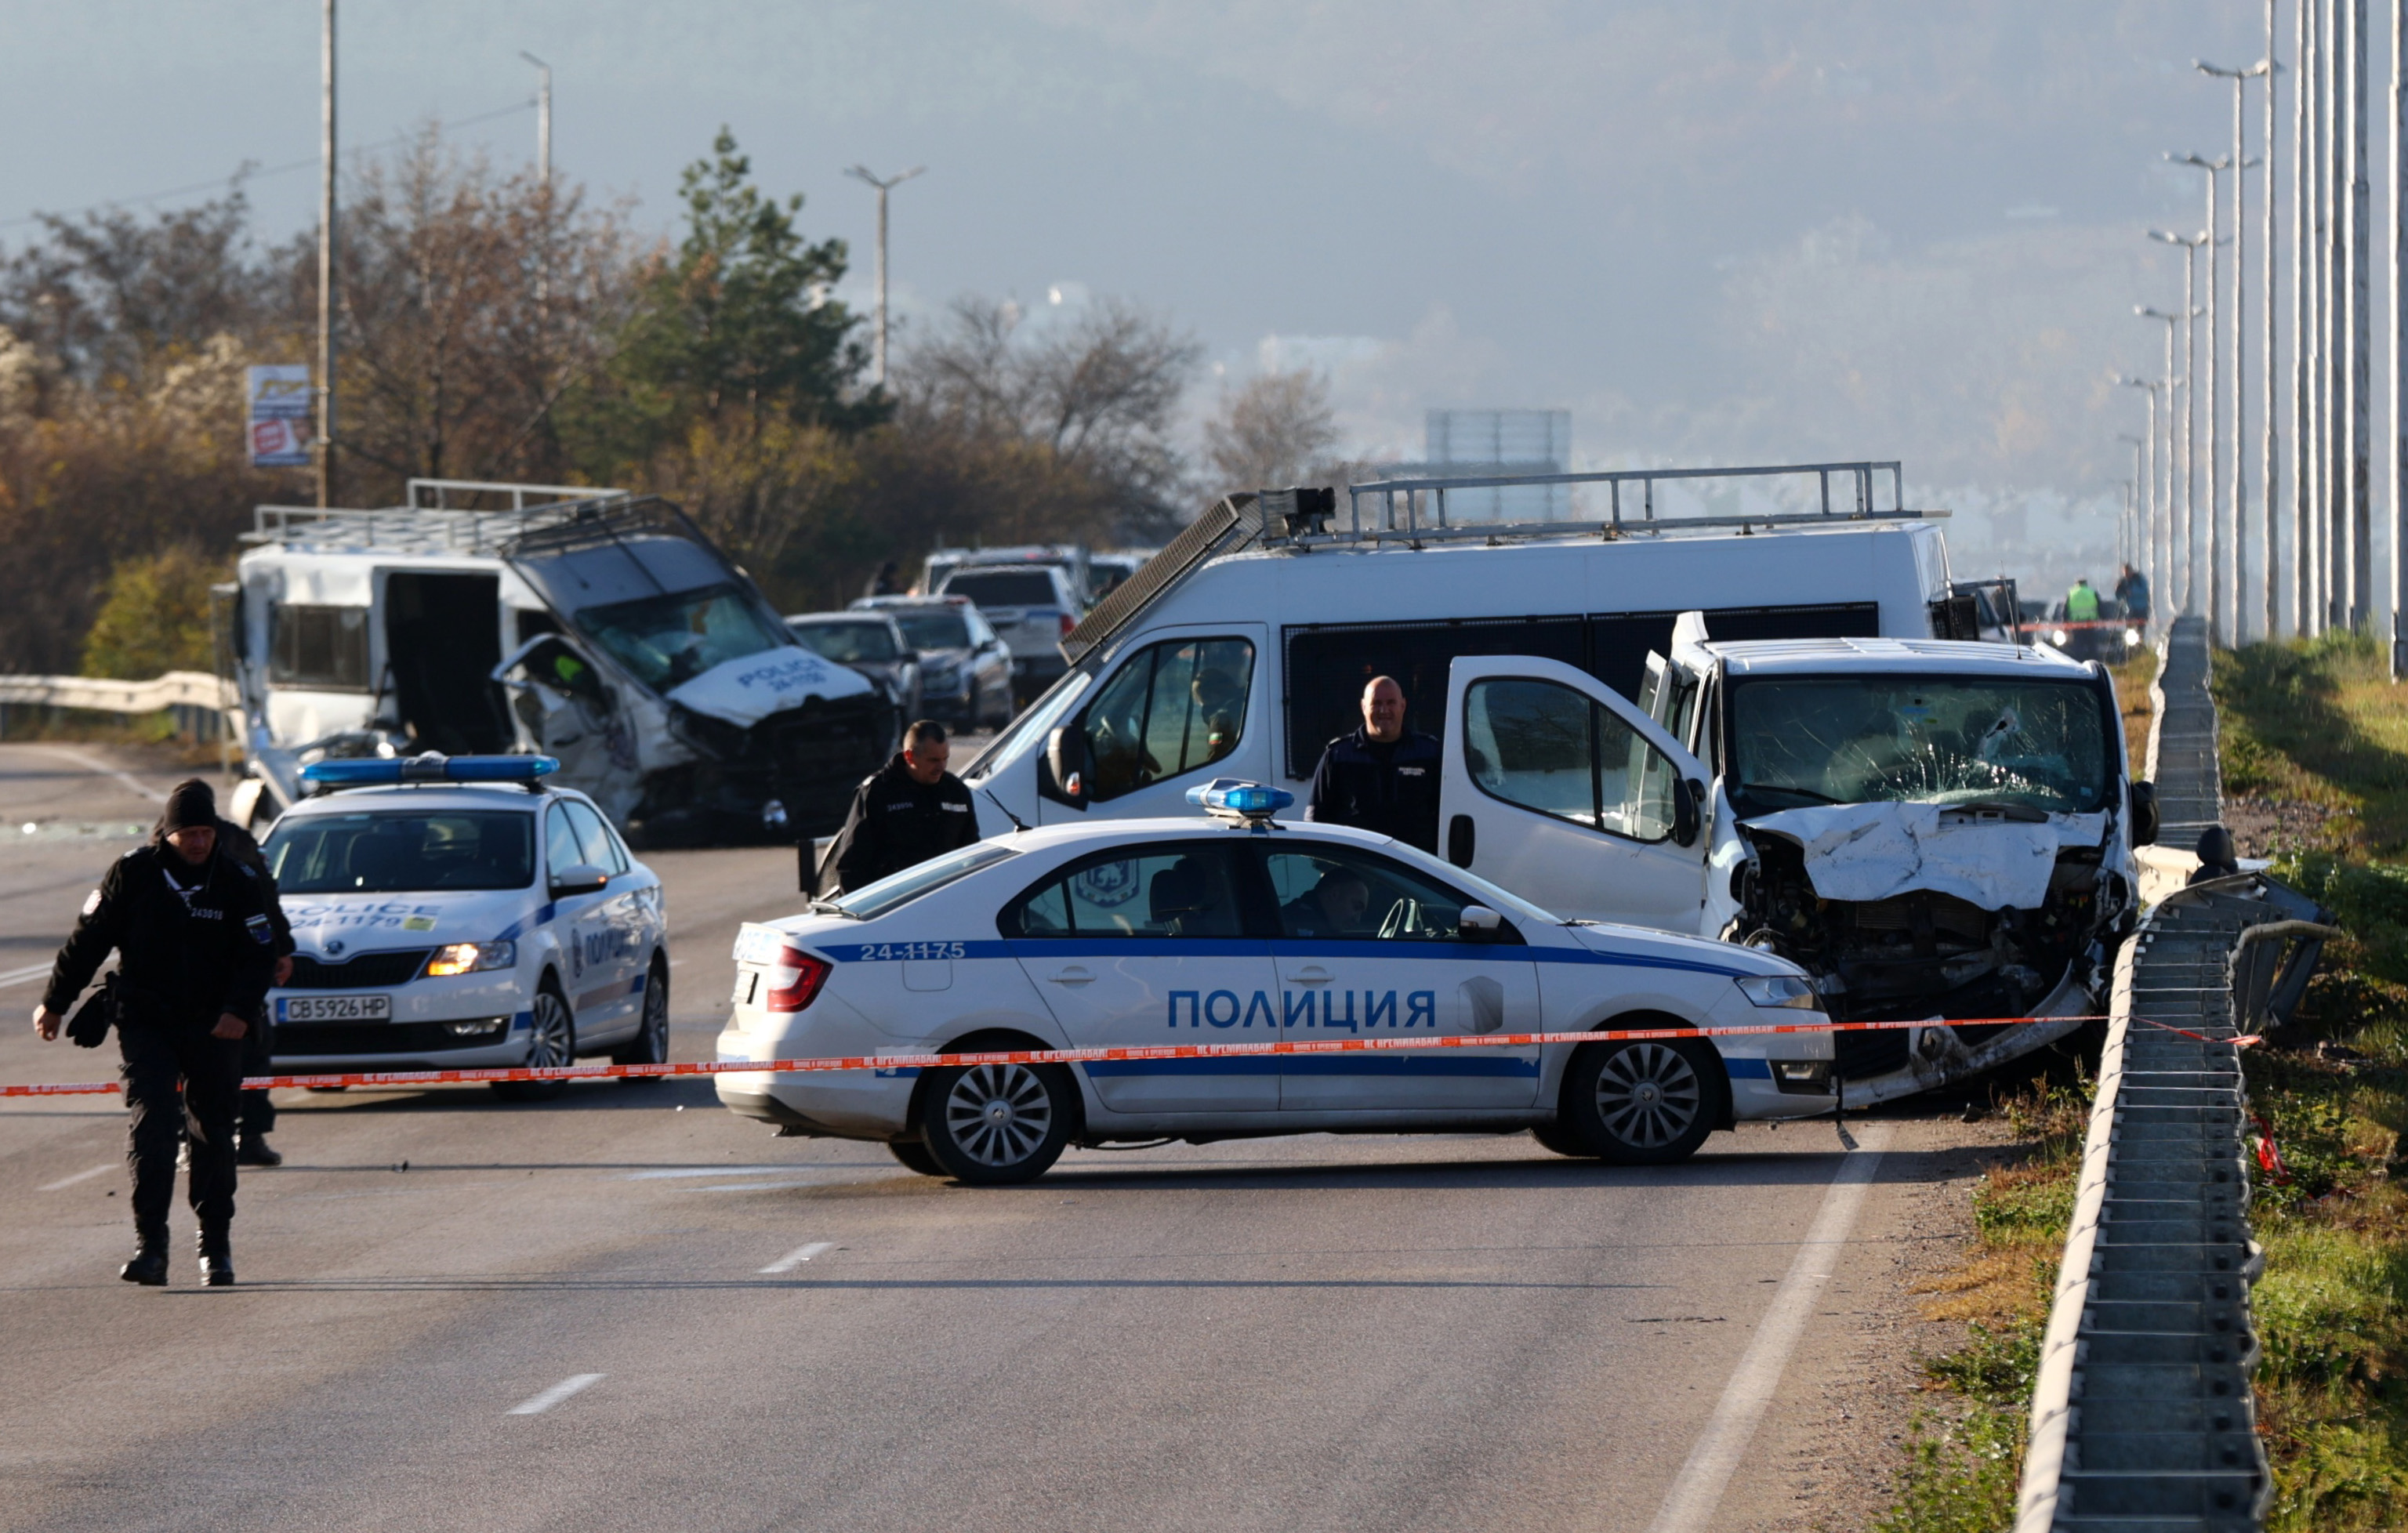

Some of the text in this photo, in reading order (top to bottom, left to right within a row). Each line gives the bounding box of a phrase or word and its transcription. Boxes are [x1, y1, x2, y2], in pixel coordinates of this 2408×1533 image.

[737, 659, 829, 687] POLICE
[861, 942, 966, 961] 24-1175
[1168, 989, 1435, 1033] ПОЛИЦИЯ
